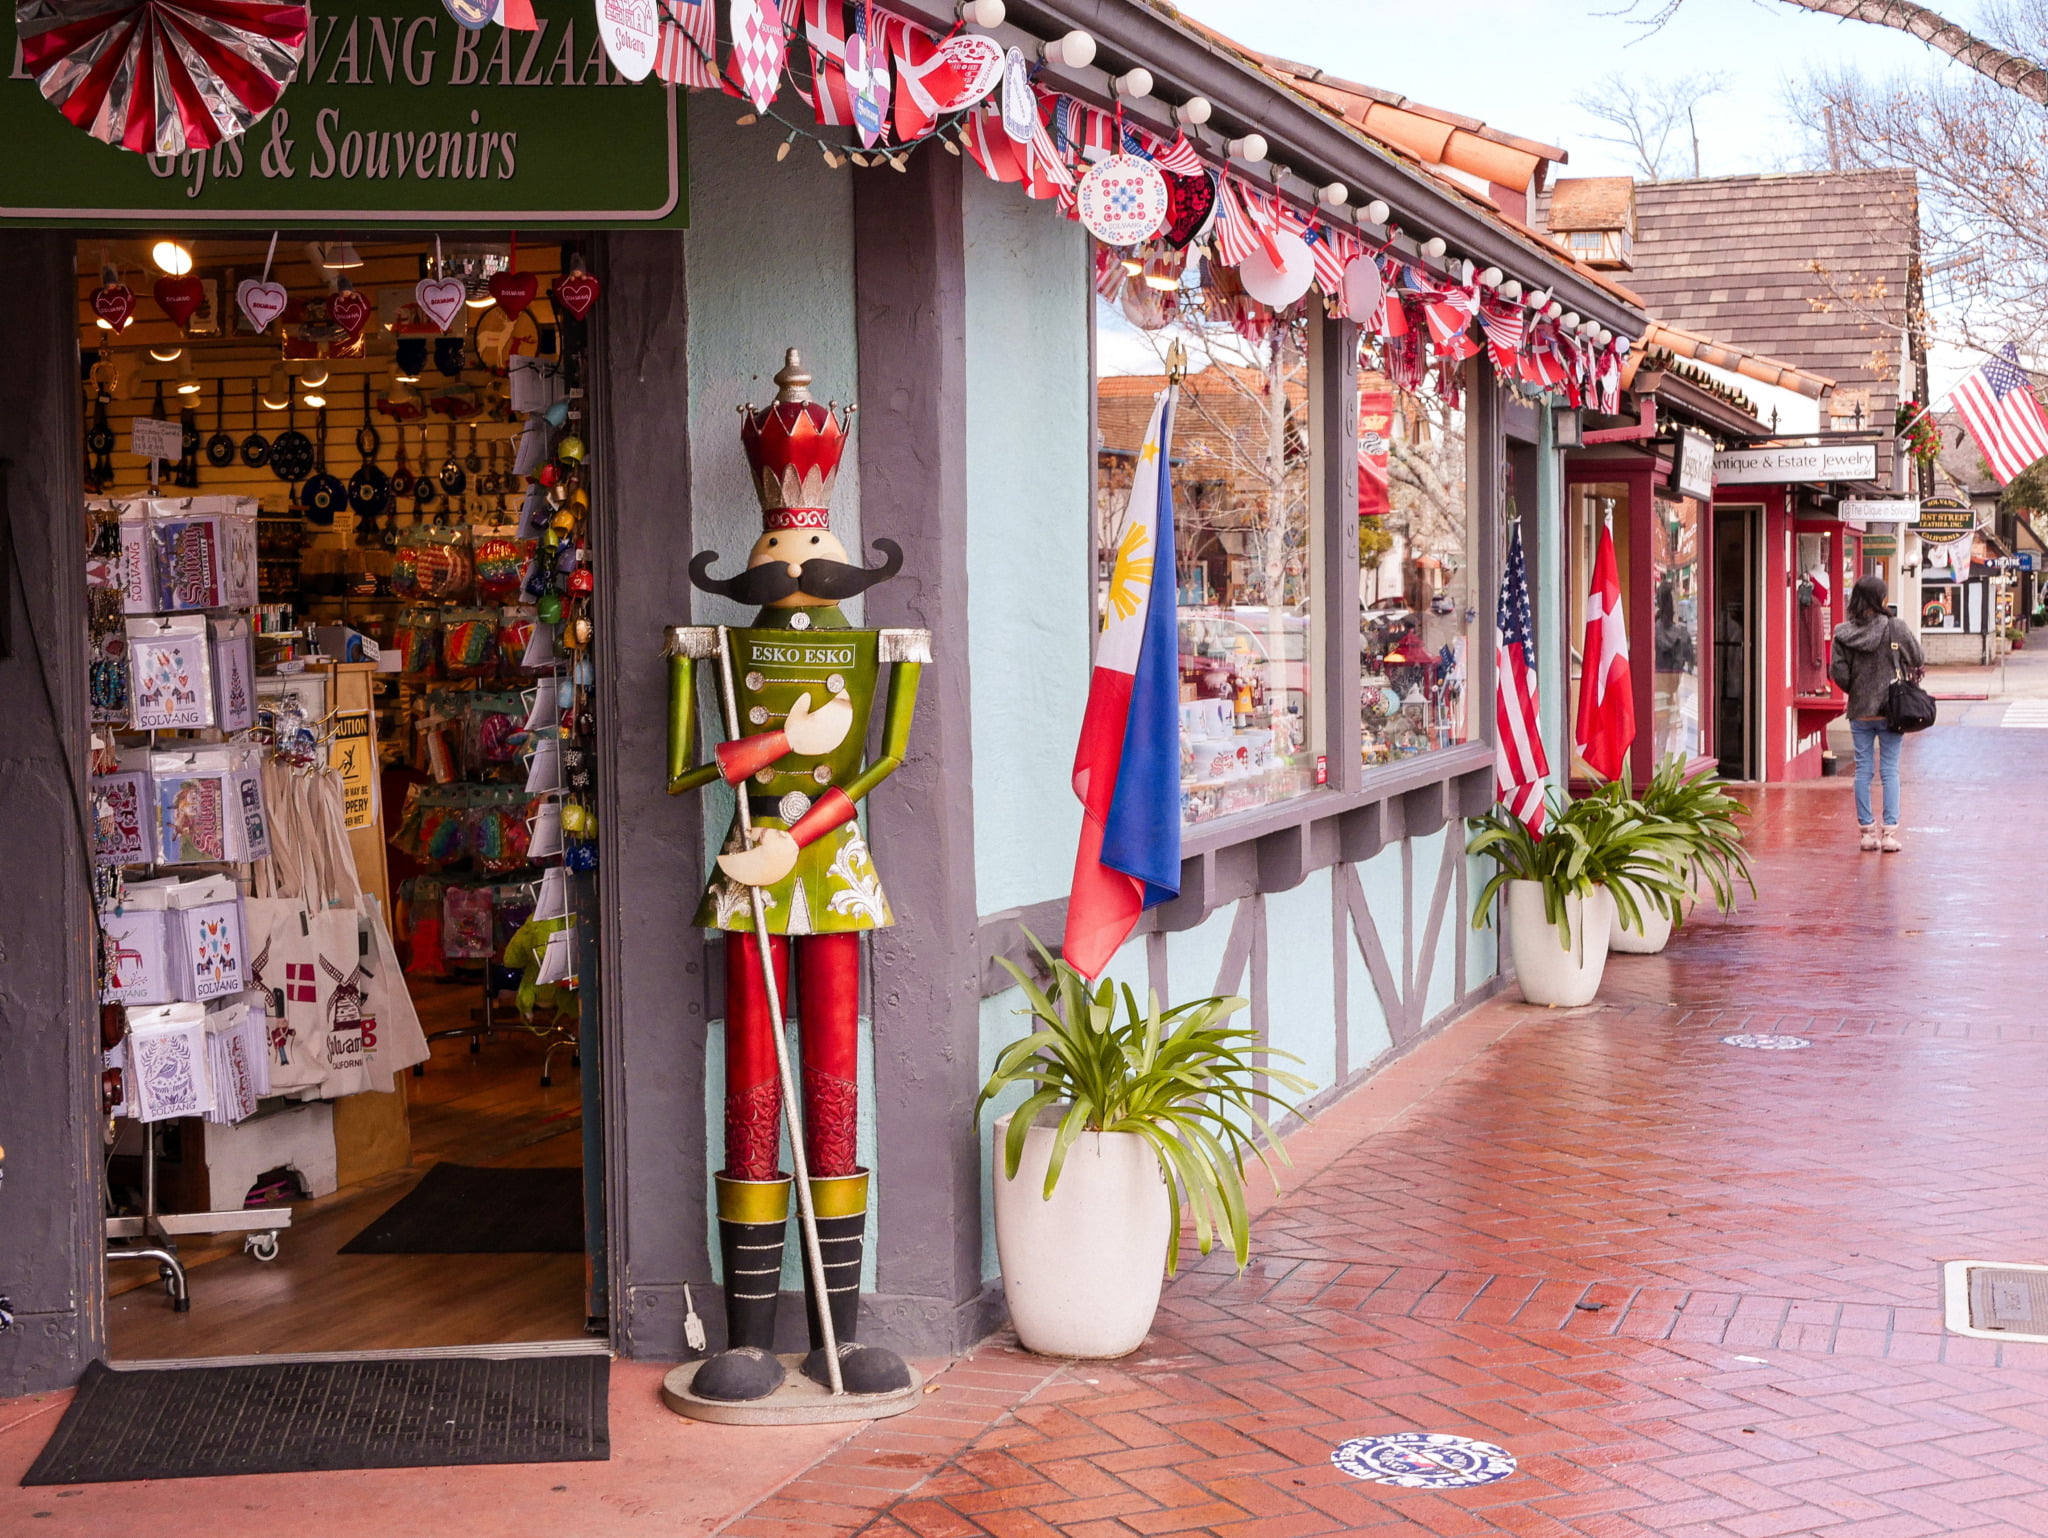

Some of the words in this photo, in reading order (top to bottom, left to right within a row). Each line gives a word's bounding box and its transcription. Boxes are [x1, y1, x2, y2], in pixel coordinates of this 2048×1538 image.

[761, 24, 783, 37] SOLVANG
[615, 27, 646, 58] Solvang
[287, 15, 437, 87] VANG
[447, 16, 645, 86] BAZAA
[260, 108, 297, 179] &
[310, 107, 518, 180] Souvenirs
[165, 295, 191, 303] SOLVANG
[501, 289, 526, 297] SOLVANG
[252, 301, 278, 311] SOLVANG
[431, 297, 455, 306] SOLVANG
[1713, 455, 1758, 473] Antique
[1762, 456, 1773, 468] &
[1778, 454, 1817, 468] Estate
[1823, 450, 1873, 469] Jewelry
[1854, 469, 1871, 477] Gold
[1864, 503, 1882, 518] Clique
[1891, 503, 1915, 518] Solvang
[1927, 499, 1958, 508] SOLVANG
[1938, 513, 1971, 521] STREET
[1922, 532, 1960, 541] CALIFORNIA
[130, 541, 142, 602] SOLVANG
[752, 646, 800, 663] ESKO
[804, 648, 852, 664] ESKO
[140, 712, 199, 728] SOLVANG
[337, 718, 367, 737] AUTION
[361, 785, 369, 795] BE
[345, 798, 369, 815] PPERY
[198, 979, 239, 996] SOLVANG
[327, 1035, 364, 1064] Solvan
[332, 1059, 364, 1070] CALIFORNI
[151, 1101, 196, 1117] SOLVANG
